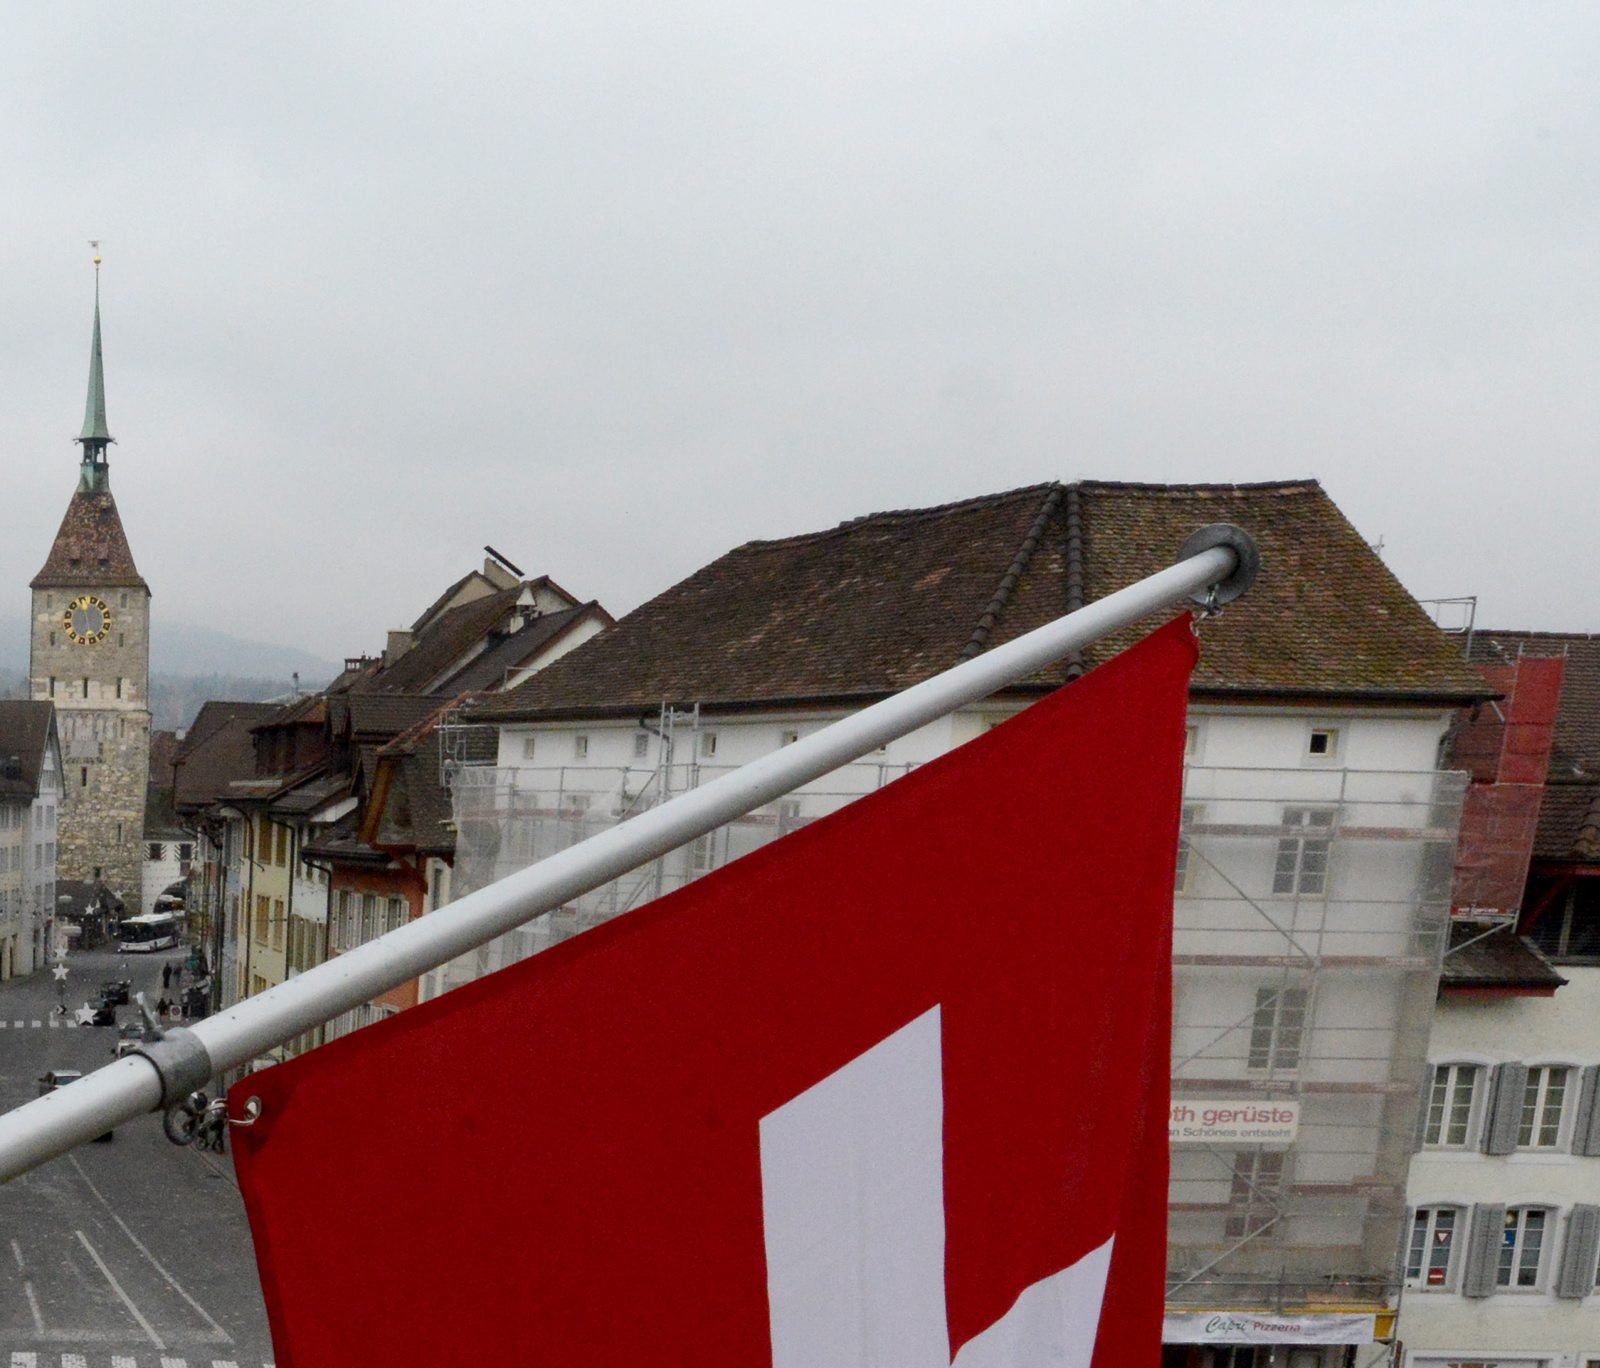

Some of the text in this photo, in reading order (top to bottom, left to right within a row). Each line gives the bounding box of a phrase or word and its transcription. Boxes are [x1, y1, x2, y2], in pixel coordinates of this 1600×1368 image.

[1169, 1106, 1294, 1127] th gerüste
[1183, 1127, 1238, 1137] Schönes
[1205, 1315, 1301, 1334] Capri Pizzeria
